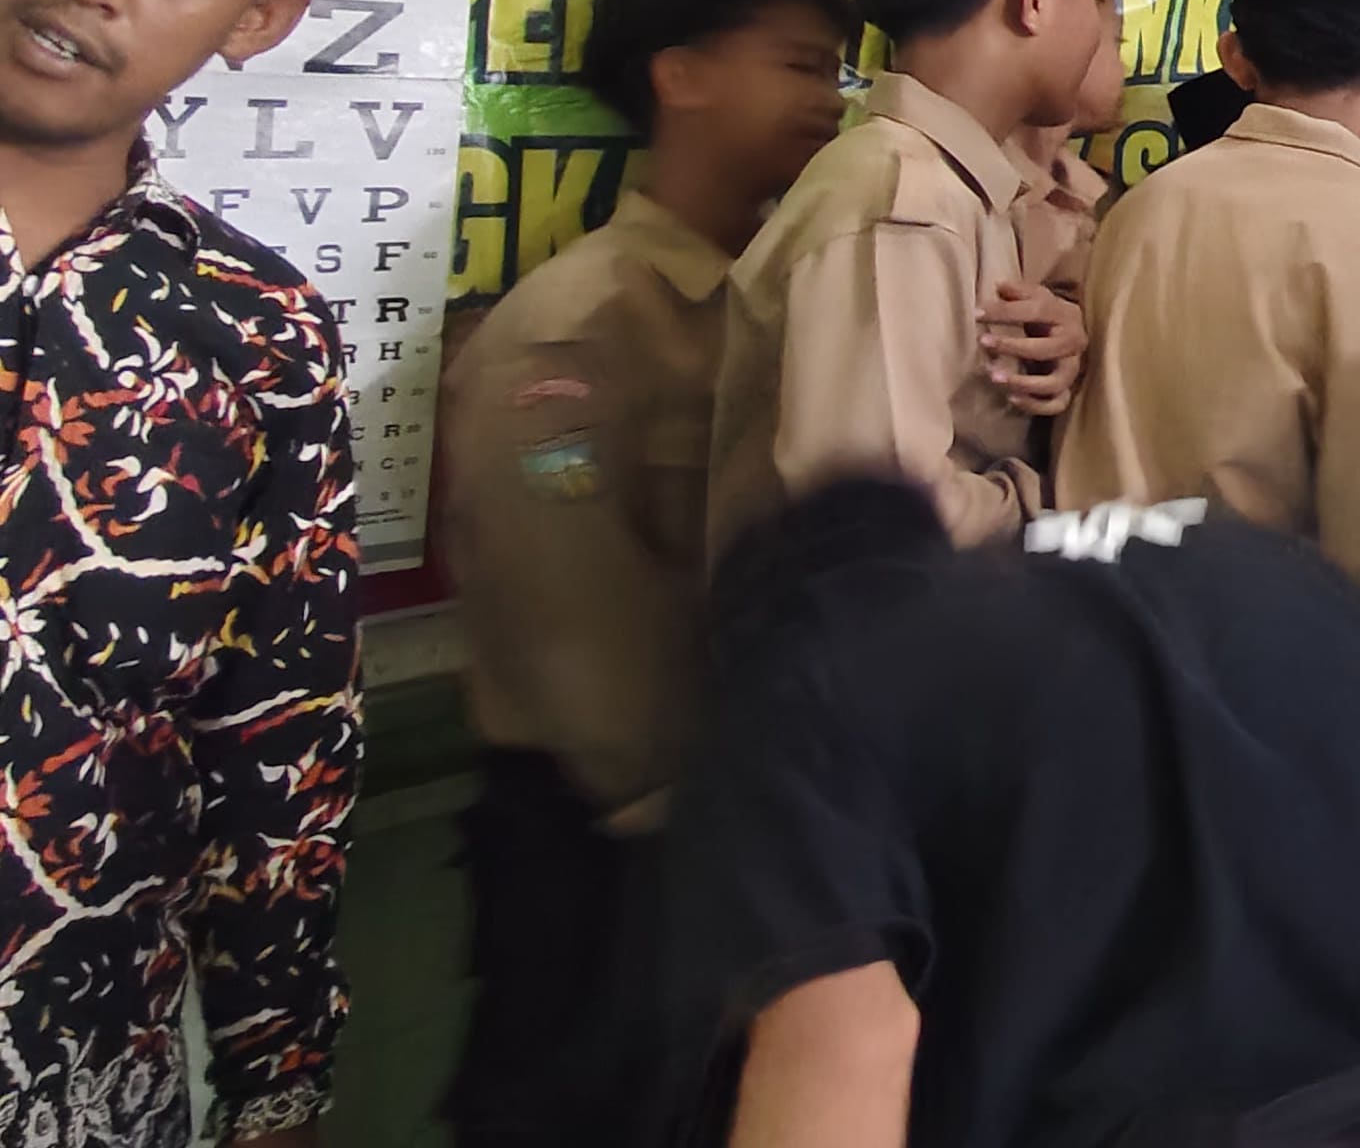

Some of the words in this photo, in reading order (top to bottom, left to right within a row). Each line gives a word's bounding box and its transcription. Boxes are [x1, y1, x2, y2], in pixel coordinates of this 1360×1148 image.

[243, 98, 315, 160] L
[348, 101, 425, 161] V
[290, 187, 332, 225] V
[361, 186, 410, 223] P
[372, 241, 411, 273] F
[375, 296, 410, 323] R
[378, 340, 403, 362] H
